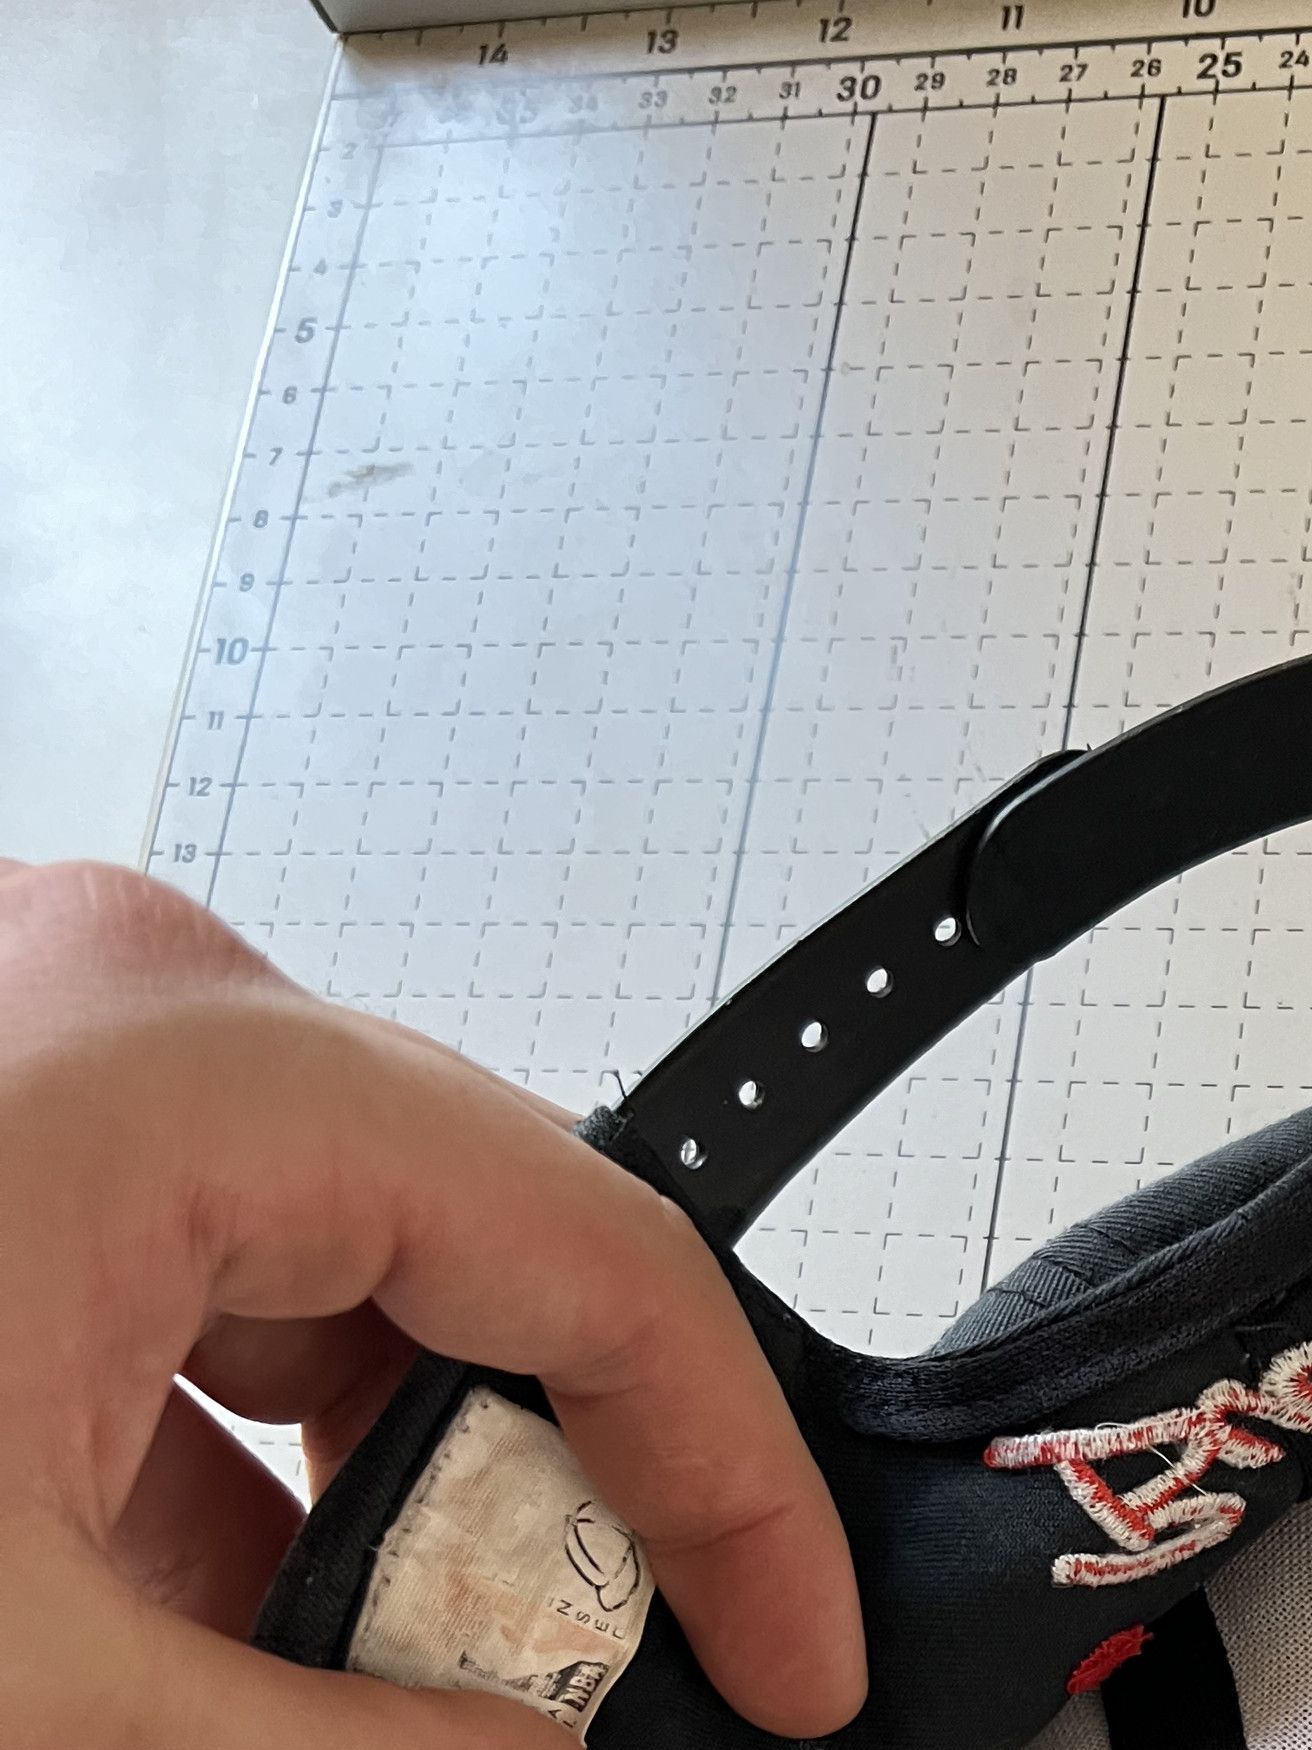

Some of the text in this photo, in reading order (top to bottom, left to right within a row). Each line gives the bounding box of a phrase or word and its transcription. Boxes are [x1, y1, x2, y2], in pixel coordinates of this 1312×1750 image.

[479, 43, 509, 67] 14
[647, 29, 680, 55] 13
[818, 16, 852, 43] 12
[1001, 5, 1025, 31] 11
[709, 86, 738, 104] 32
[779, 81, 801, 99] 31
[836, 74, 883, 102] 30
[914, 72, 946, 92] 29
[985, 68, 1018, 88] 28
[1059, 63, 1089, 83] 27
[1130, 58, 1162, 78] 26
[1196, 51, 1243, 80] 25
[1278, 49, 1310, 69] 24
[294, 316, 319, 344] 5
[281, 386, 299, 406] 6
[268, 447, 285, 467] 7
[253, 510, 269, 528] 8
[239, 573, 257, 593] 9
[214, 637, 250, 666] 10
[207, 711, 226, 731] 11
[188, 776, 213, 798] 12
[172, 843, 198, 864] 13
